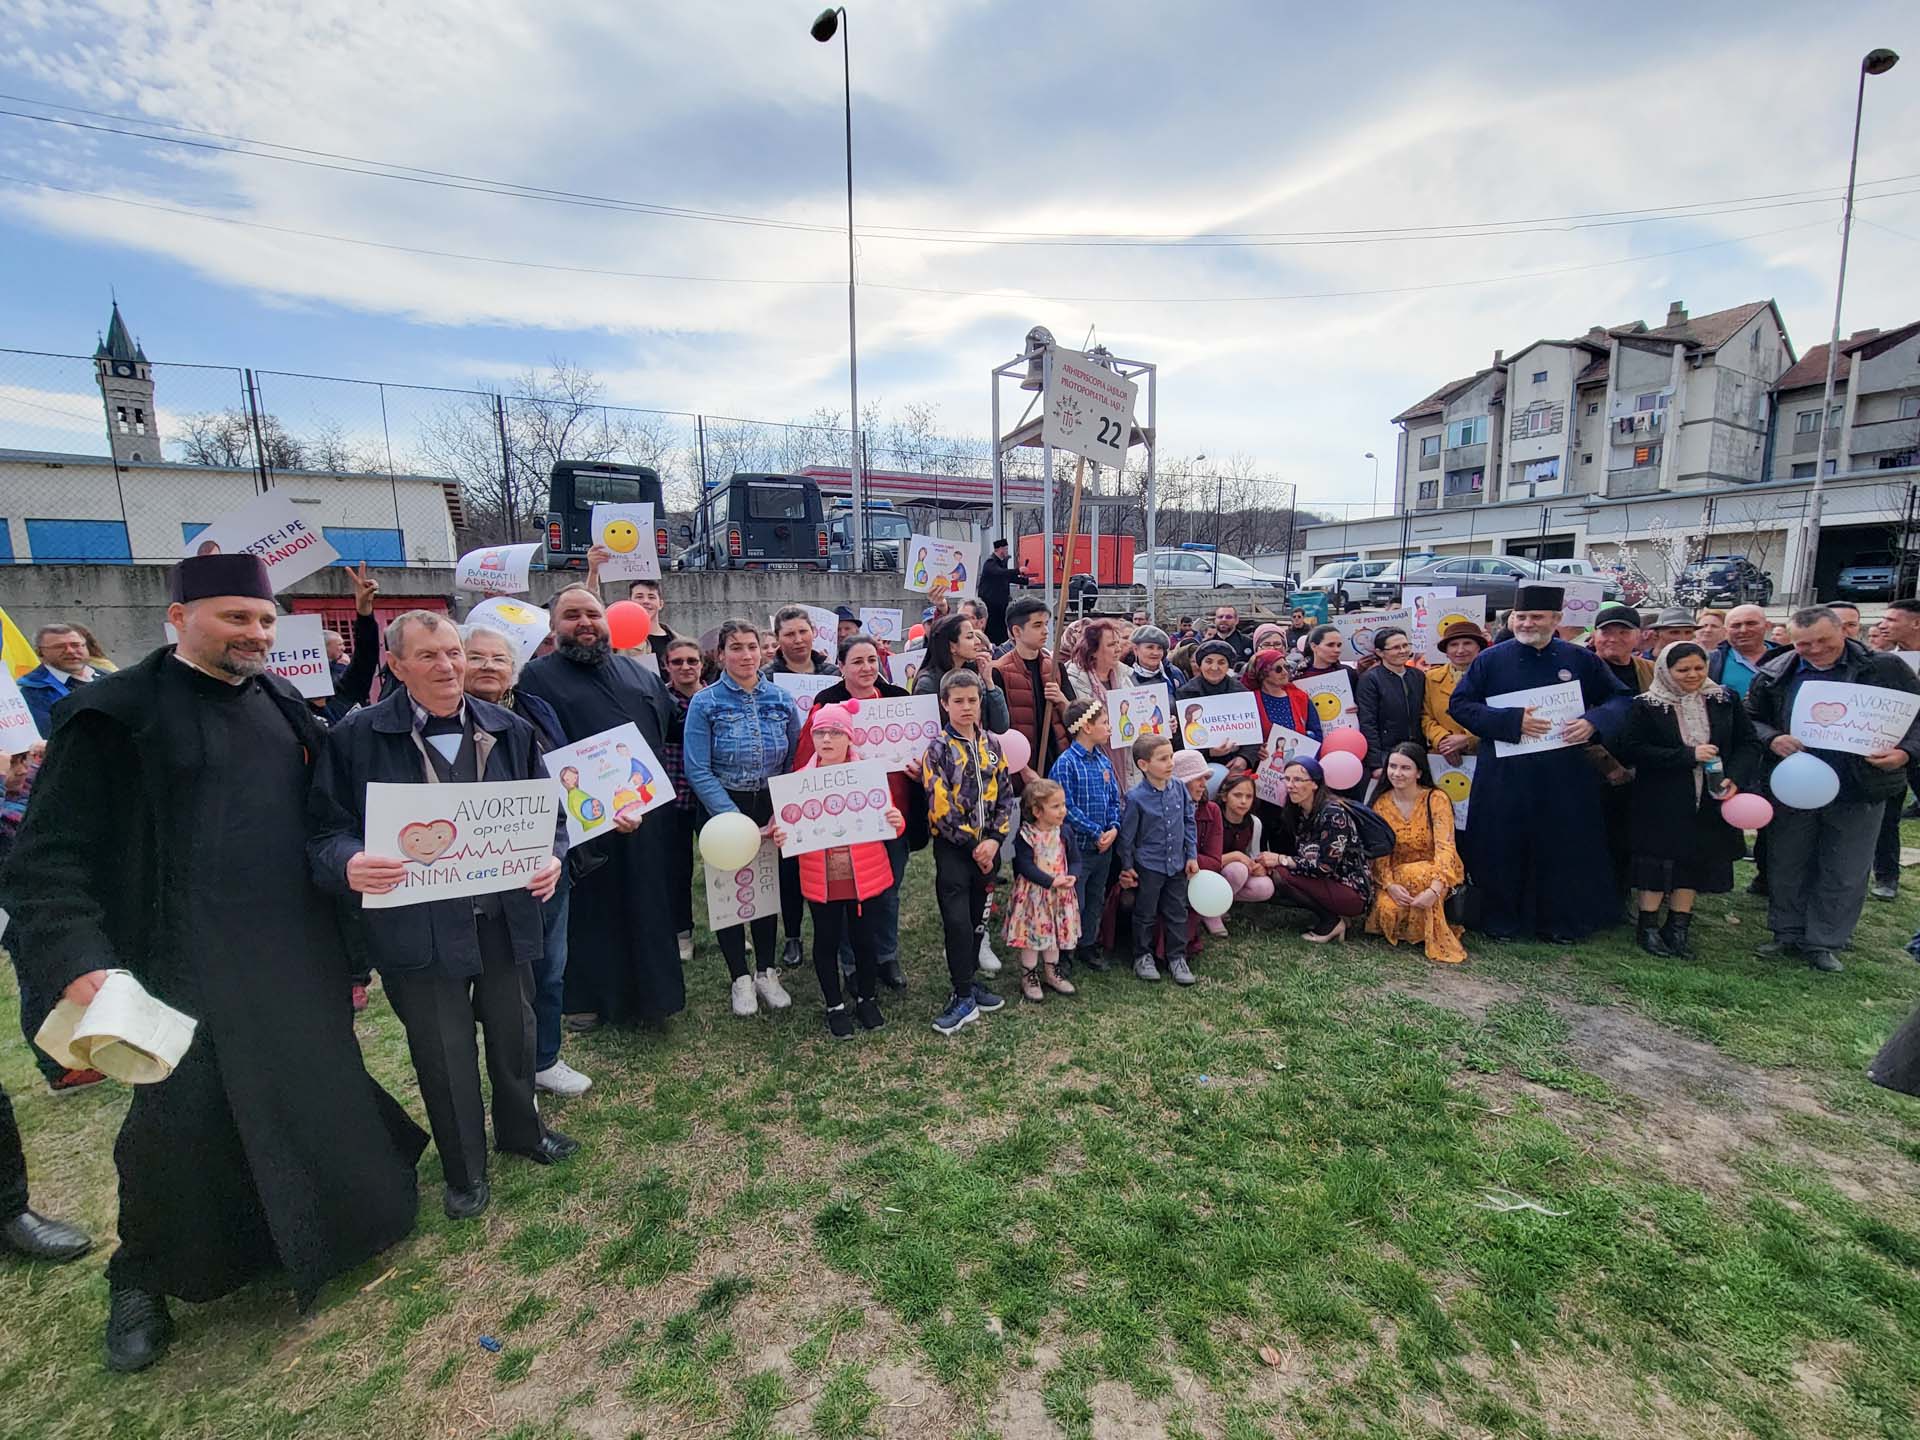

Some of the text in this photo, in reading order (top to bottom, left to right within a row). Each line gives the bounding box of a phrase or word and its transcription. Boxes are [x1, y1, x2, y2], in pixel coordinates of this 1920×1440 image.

[1062, 363, 1106, 390] ARHIEPISCOPIA
[1061, 377, 1108, 407] PROTOPOPIATUL
[1096, 416, 1122, 449] 22
[286, 519, 306, 535] PE
[1364, 615, 1390, 624] PENTRU
[302, 648, 320, 660] PE
[866, 701, 915, 720] ALEGE
[1245, 711, 1257, 720] PE
[1846, 693, 1913, 718] AVORTUL
[799, 768, 858, 794] ALEGE
[453, 795, 551, 822] AVORTUL
[466, 867, 498, 881] care
[501, 855, 542, 876] BATE
